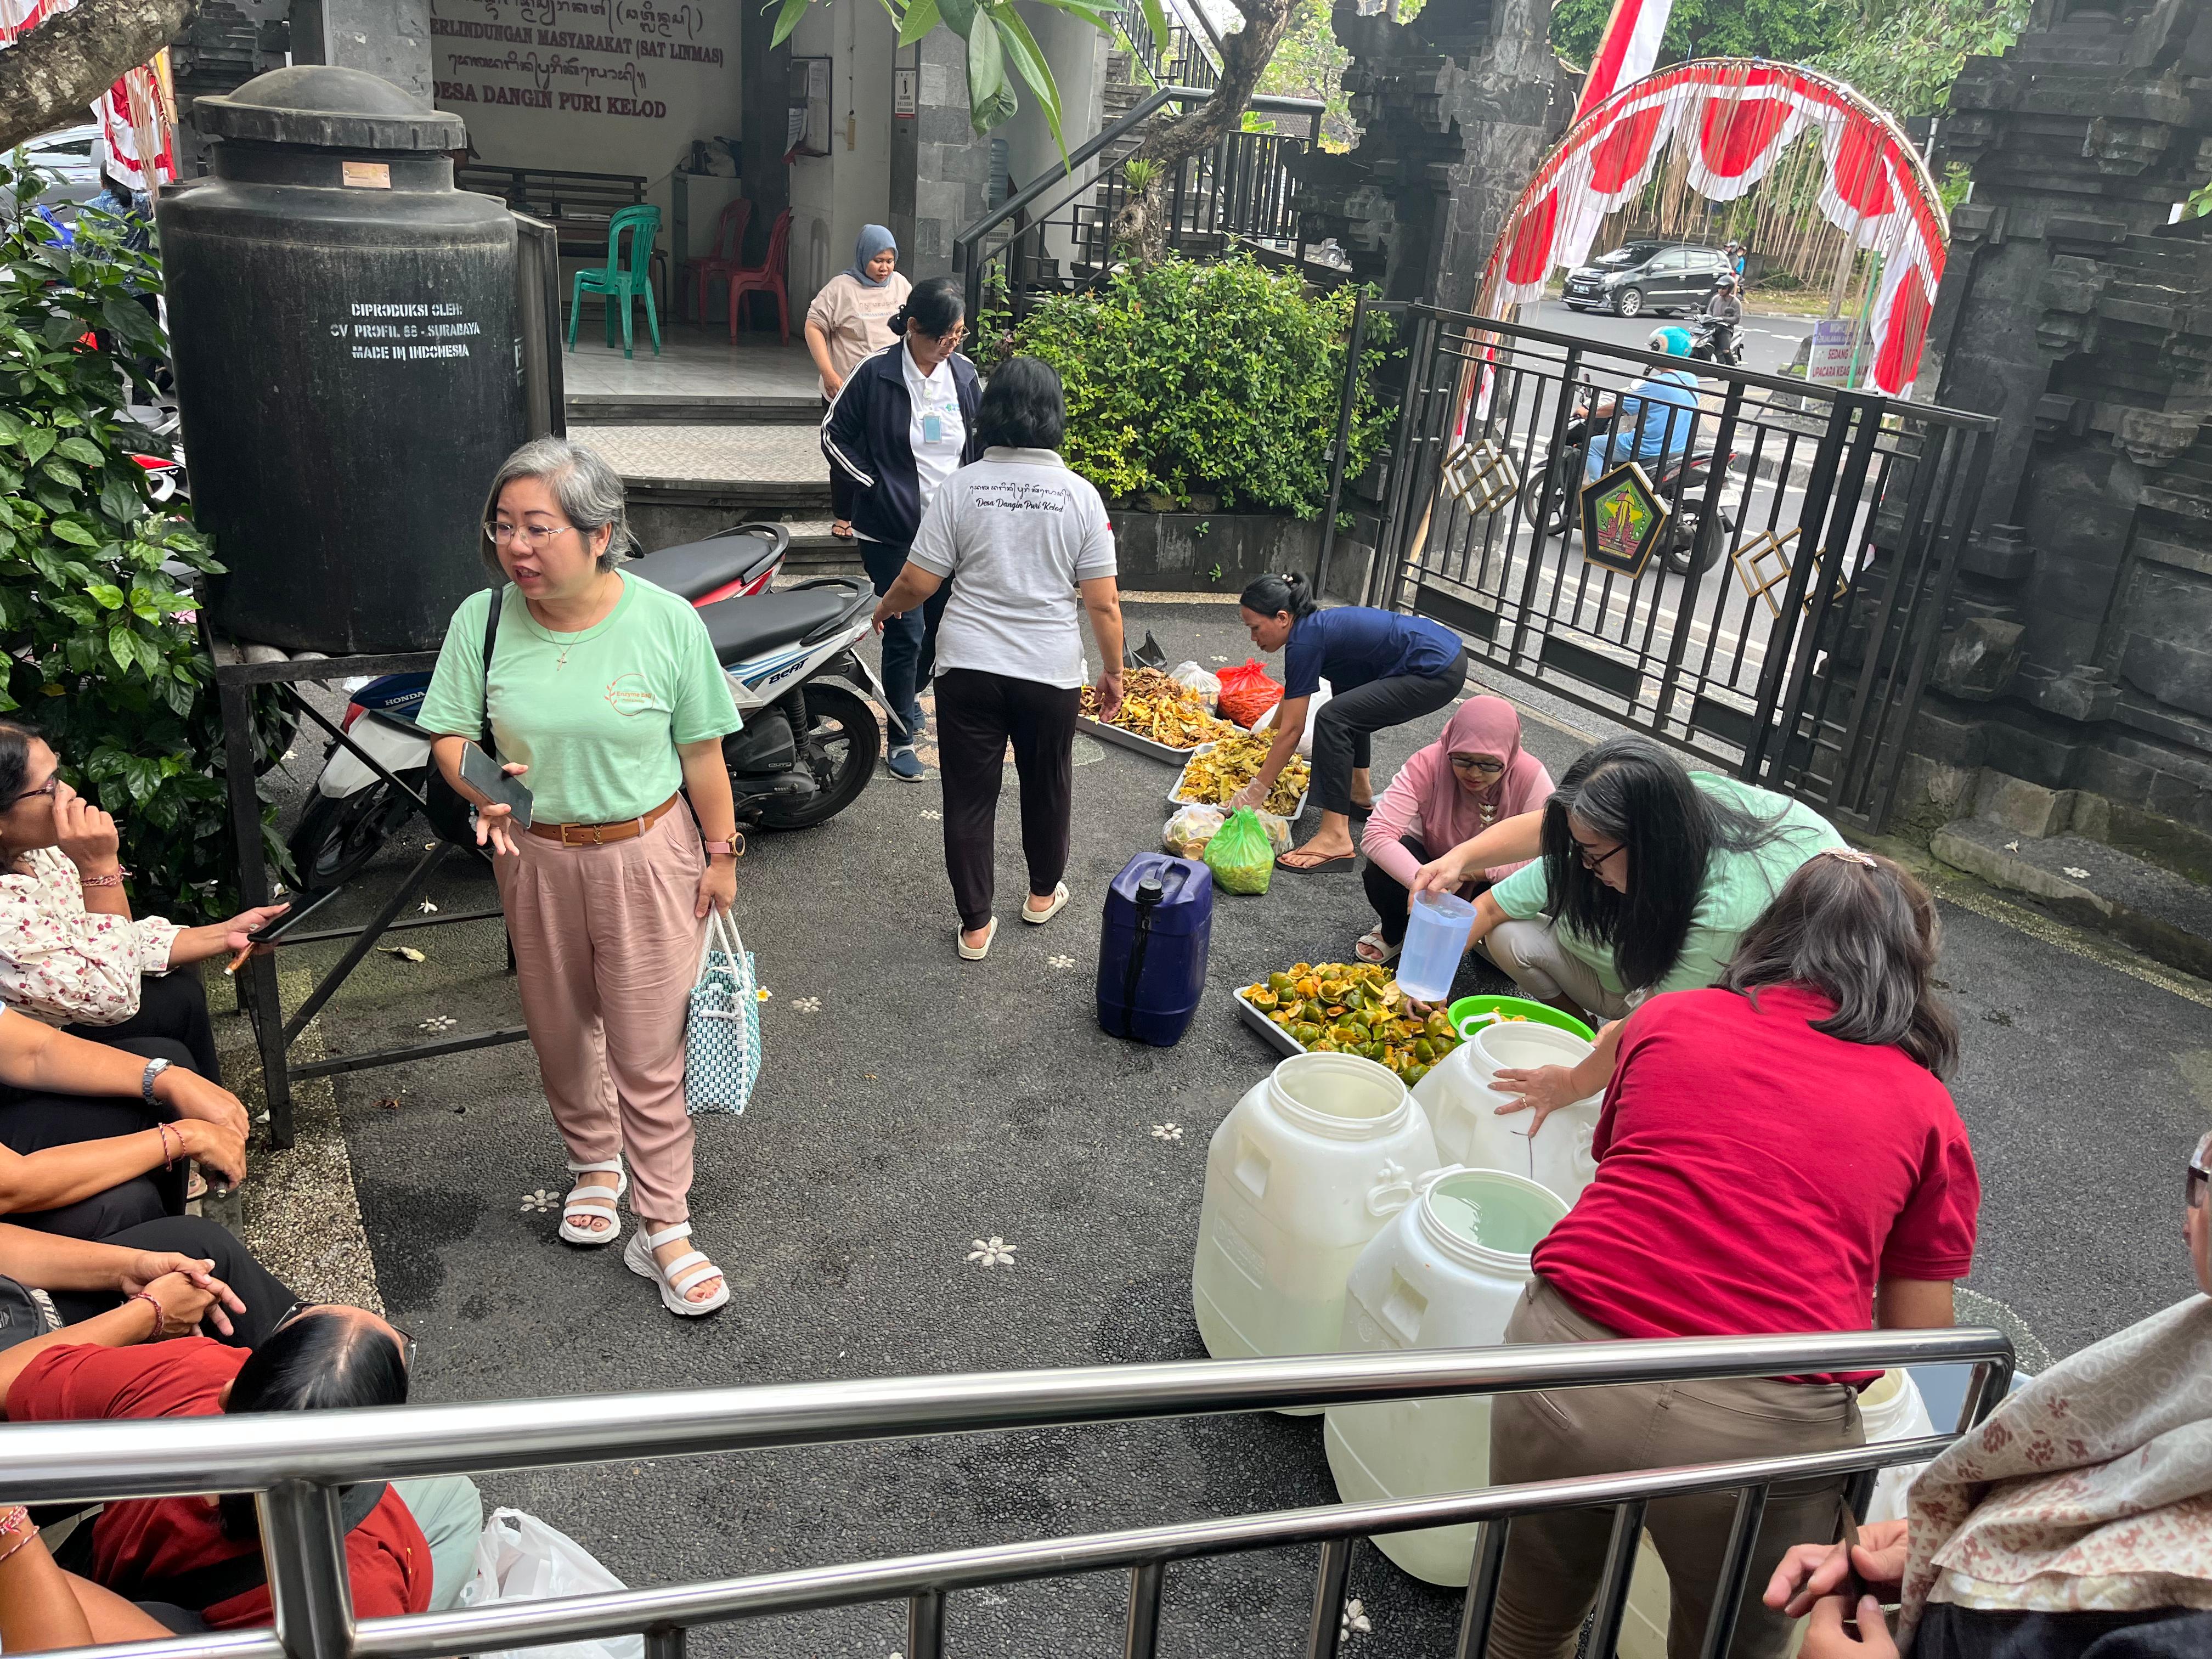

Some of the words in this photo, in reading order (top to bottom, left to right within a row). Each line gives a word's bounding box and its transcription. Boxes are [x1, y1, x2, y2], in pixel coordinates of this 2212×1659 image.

[430, 18, 533, 44] ERLINDUNGAN
[537, 29, 632, 54] MASYARAKAT
[636, 40, 665, 60] (SAT
[670, 43, 723, 69] LINMAS)
[482, 85, 552, 108] DANGIN
[559, 92, 602, 113] PURI
[607, 97, 667, 119] KELOD
[351, 303, 428, 317] DIPRODUKSI
[330, 324, 348, 336] CV
[354, 325, 400, 337] PROFIL
[428, 322, 480, 336] SURABAYA
[352, 346, 390, 359] MADE
[393, 346, 405, 361] IN
[409, 344, 470, 358] INDONESIA
[976, 498, 994, 507] Desa
[996, 498, 1023, 511] Dangin
[1024, 500, 1041, 510] Puri
[1042, 501, 1064, 512] Kelod
[385, 691, 426, 706] HONDA
